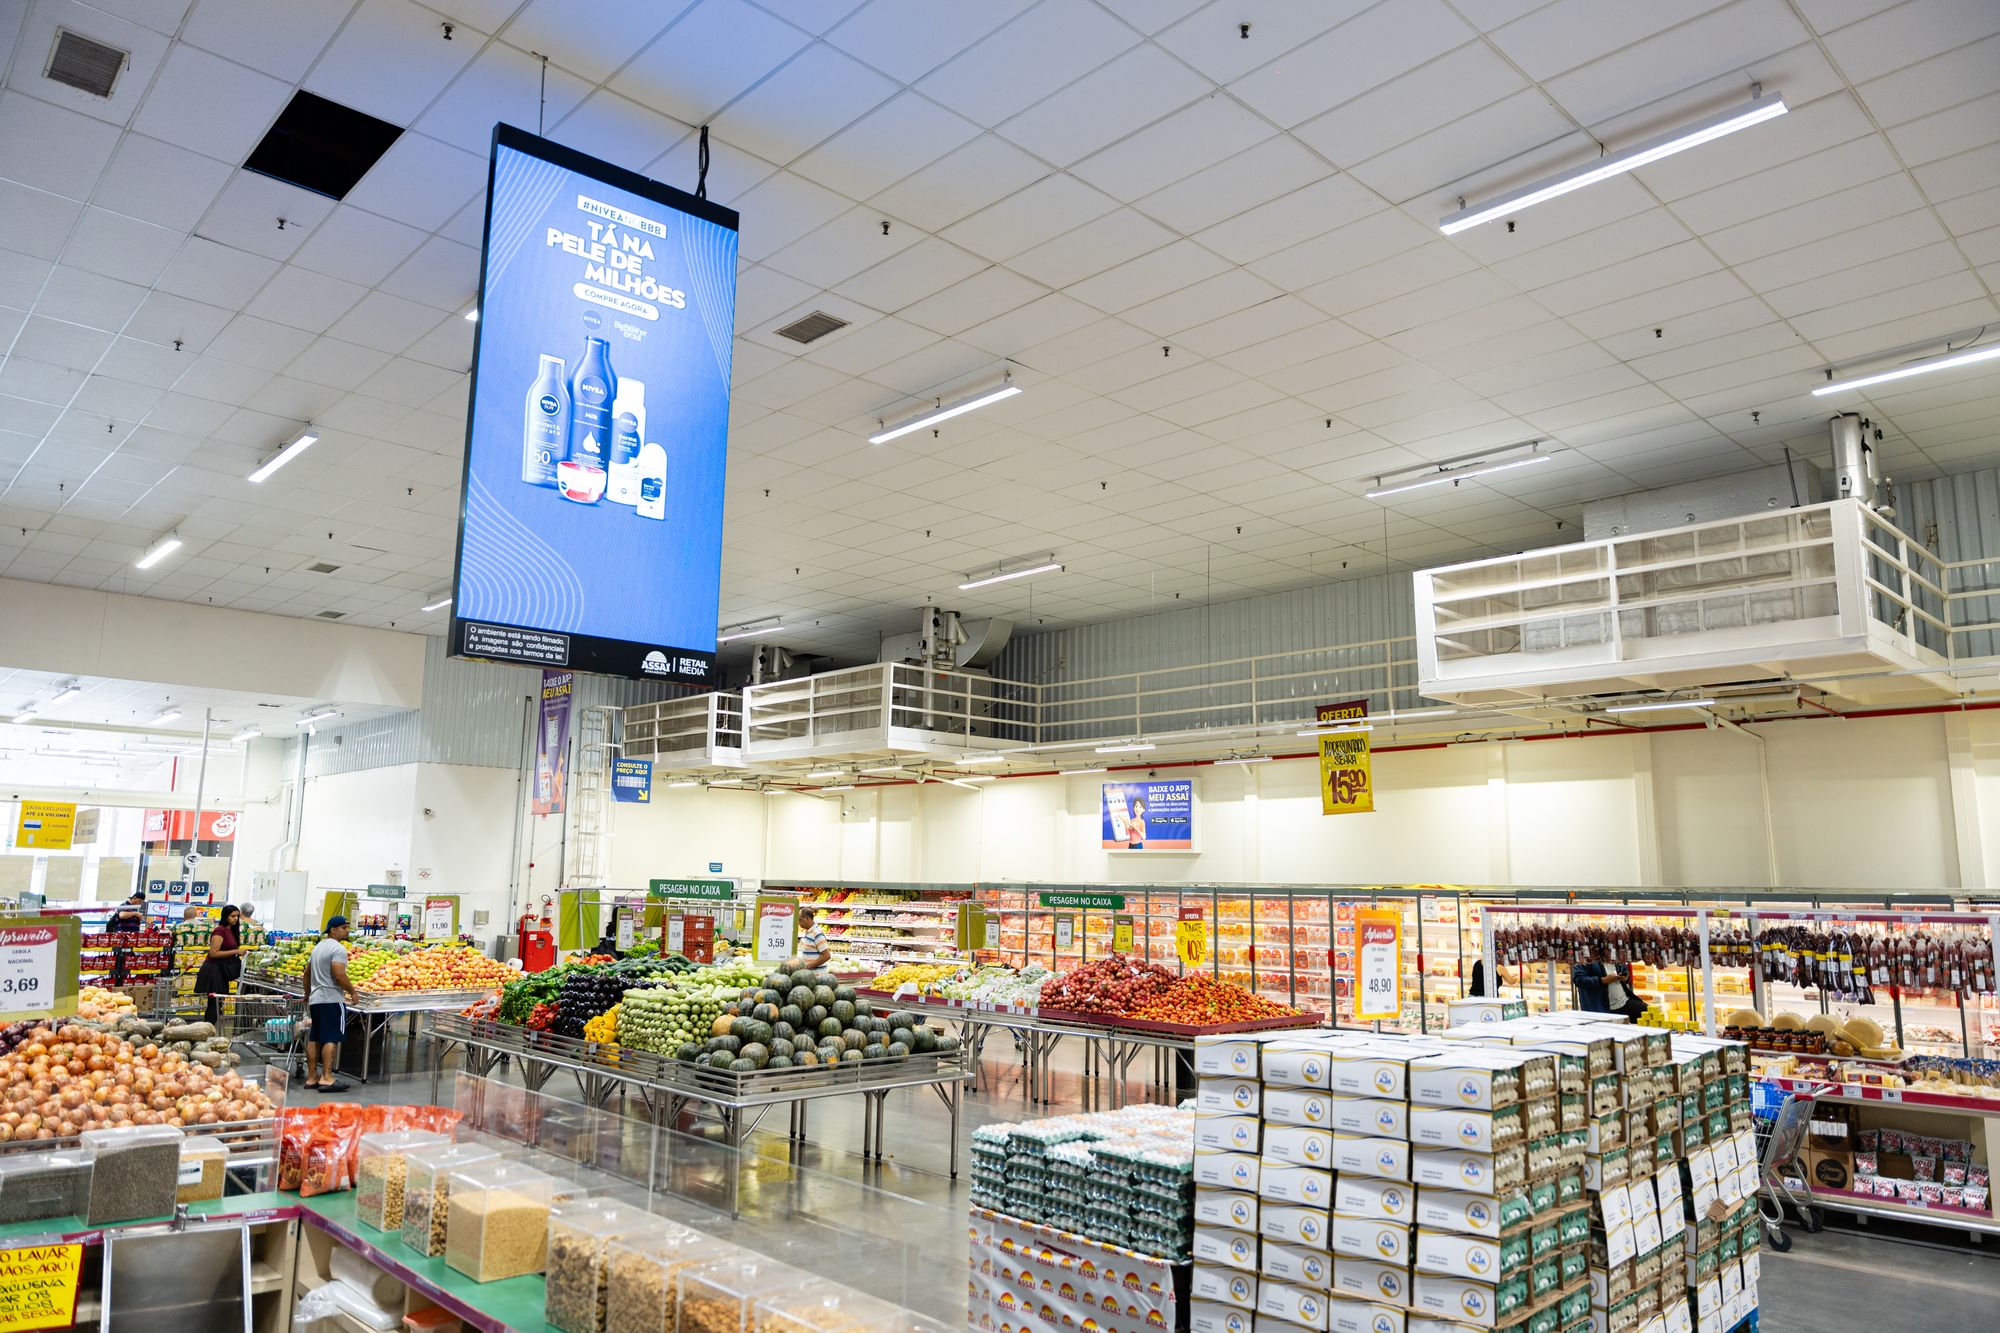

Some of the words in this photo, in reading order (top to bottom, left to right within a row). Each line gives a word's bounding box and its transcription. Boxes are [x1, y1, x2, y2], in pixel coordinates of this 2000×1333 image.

[587, 220, 618, 248] TÁ
[623, 233, 655, 261] NA
[547, 228, 606, 264] PELE
[611, 249, 642, 276] DE
[584, 262, 687, 310] MILHÕES
[585, 290, 618, 305] COMPRE
[621, 299, 648, 314] AGORA
[582, 384, 604, 395] NIVEA
[478, 629, 506, 637] ambiente
[542, 636, 564, 645] filmado.
[476, 644, 508, 653] protegidas
[482, 636, 508, 646] imagens
[526, 642, 564, 652] confidenciais
[680, 658, 708, 668] RETAIL
[679, 666, 705, 676] MEDIA
[1321, 707, 1364, 721] OFERTA
[1334, 755, 1357, 766] SEARA
[660, 884, 688, 894] PESAGEM
[690, 885, 700, 894] NO
[701, 885, 720, 895] CAIXA
[1050, 896, 1079, 905] PESAGEM
[1081, 897, 1090, 905] NO
[1092, 898, 1112, 906] CAIXA
[432, 922, 448, 930] 11,90
[768, 938, 784, 949] 3,59
[3, 978, 38, 994] 3,69
[1369, 978, 1391, 995] 48,90
[1308, 1106, 1320, 1114] AJA
[1463, 1129, 1477, 1137] AJA
[1381, 1157, 1393, 1165] AJA
[1386, 1198, 1399, 1206] AJA
[1471, 1210, 1485, 1219] AJA
[1304, 1225, 1315, 1233] AJA
[1381, 1240, 1395, 1249] AJA
[19, 1247, 70, 1262] LAVAR
[1472, 1256, 1486, 1265] AJA
[36, 1262, 74, 1274] AQUI
[1307, 1265, 1319, 1273] AJA
[0, 1279, 66, 1293] XCLUSIVA
[1383, 1281, 1396, 1290] AJA
[1467, 1299, 1481, 1308] AJA
[21, 1308, 66, 1319] SECAS
[1303, 1305, 1315, 1313] AJA
[1377, 1323, 1391, 1332] AJA
